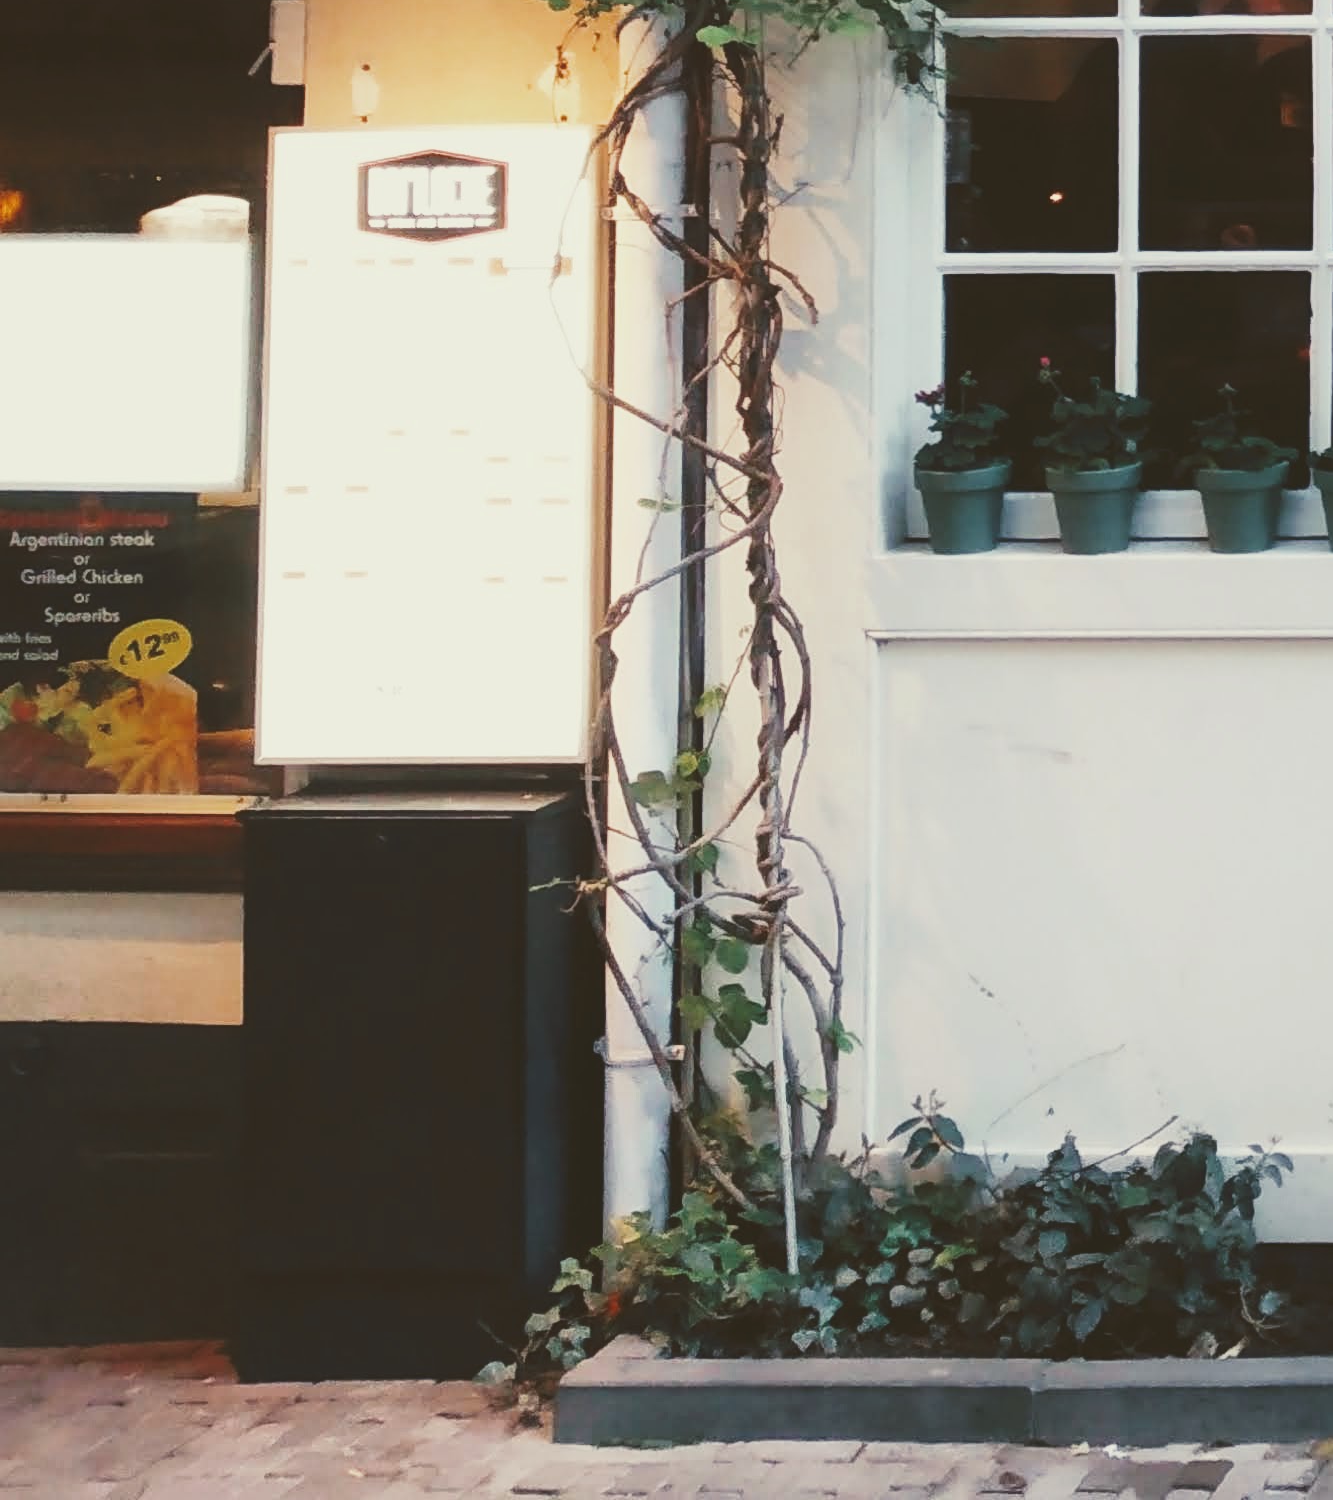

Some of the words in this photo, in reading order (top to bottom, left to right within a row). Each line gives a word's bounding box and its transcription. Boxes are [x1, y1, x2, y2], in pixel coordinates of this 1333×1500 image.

[9, 530, 104, 551] Argentinian
[110, 530, 155, 547] steak
[73, 555, 91, 566] or
[20, 568, 77, 584] Grilled
[82, 568, 144, 584] Chicken
[73, 593, 91, 604] or
[44, 607, 121, 627] Spareribs
